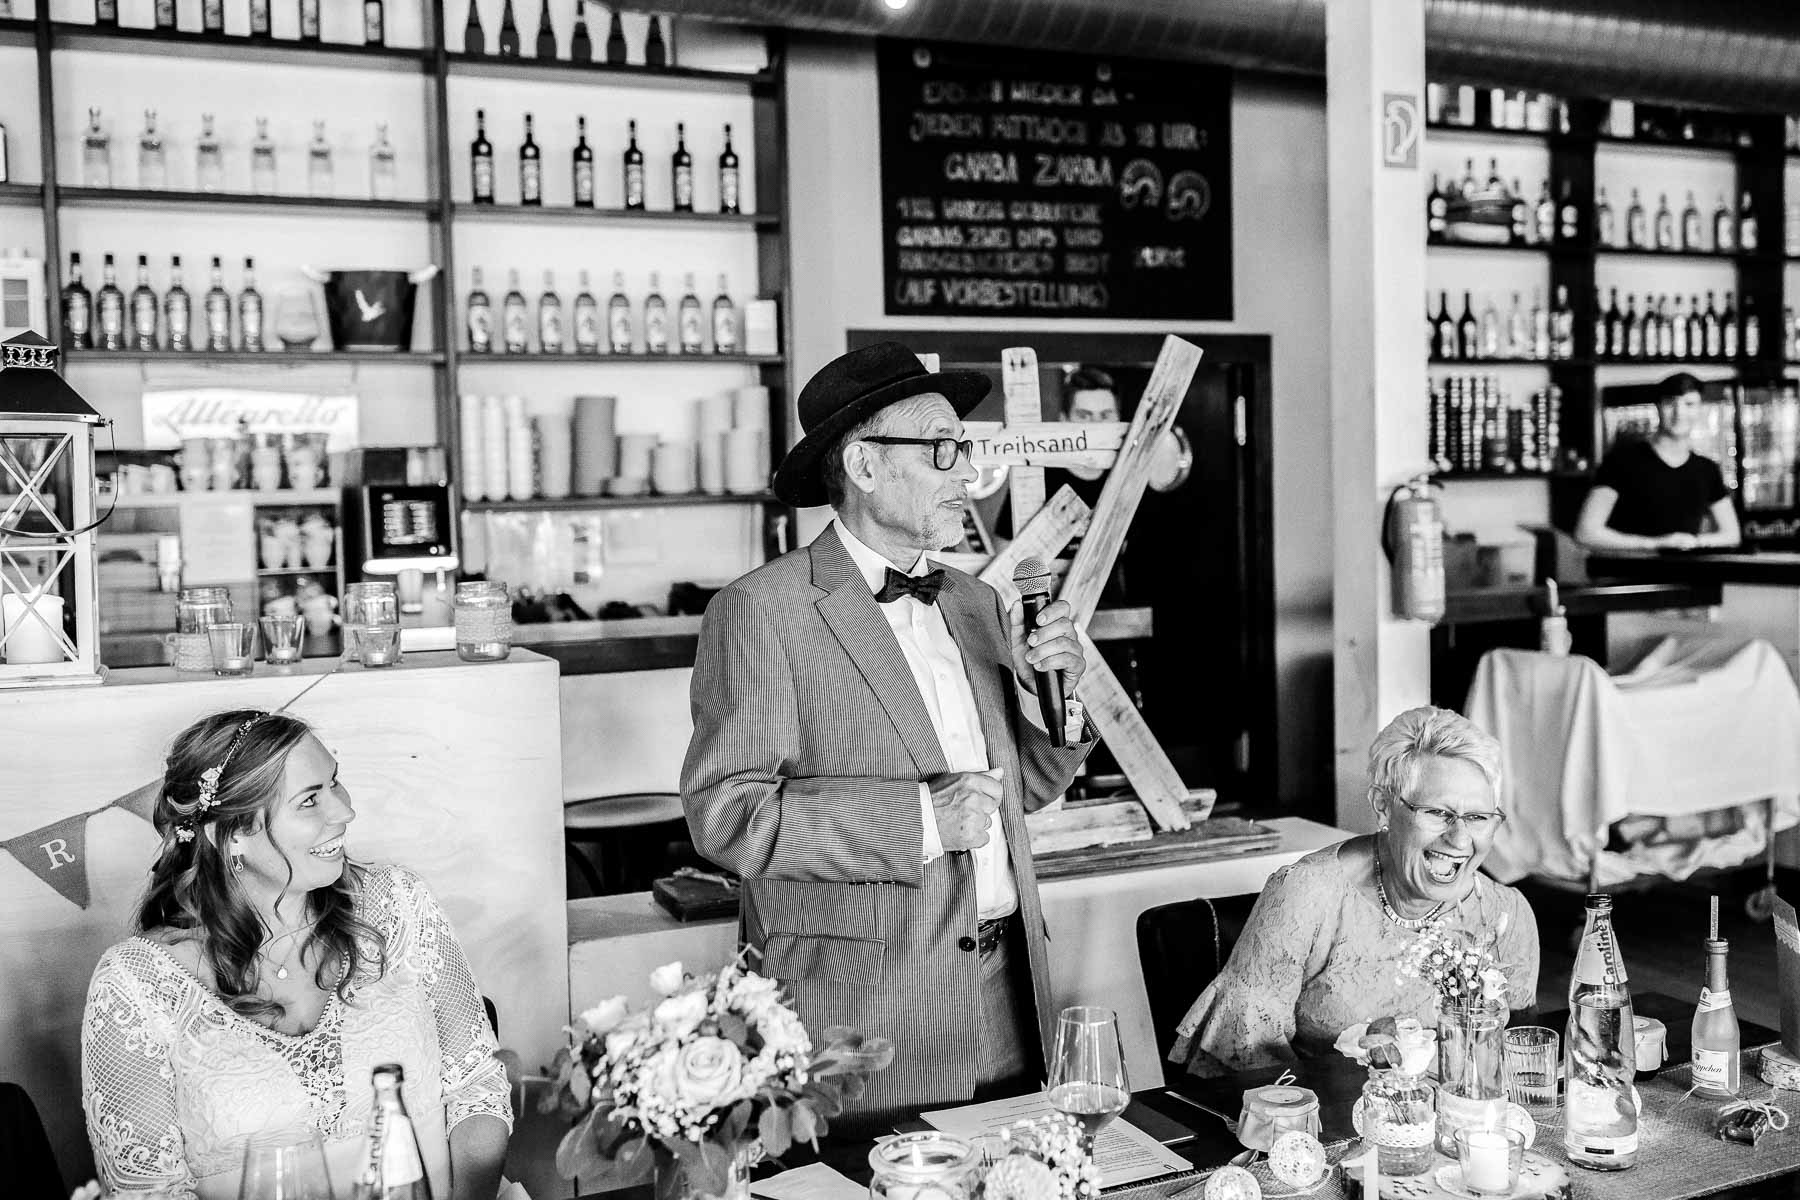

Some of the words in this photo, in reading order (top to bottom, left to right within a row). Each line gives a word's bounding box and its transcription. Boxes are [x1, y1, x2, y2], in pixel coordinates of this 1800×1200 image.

[909, 111, 982, 142] JEDEN
[944, 151, 1019, 184] GAMBA
[1033, 153, 1114, 187] ZAMBA
[976, 429, 1088, 456] Treibsand
[39, 838, 76, 870] R
